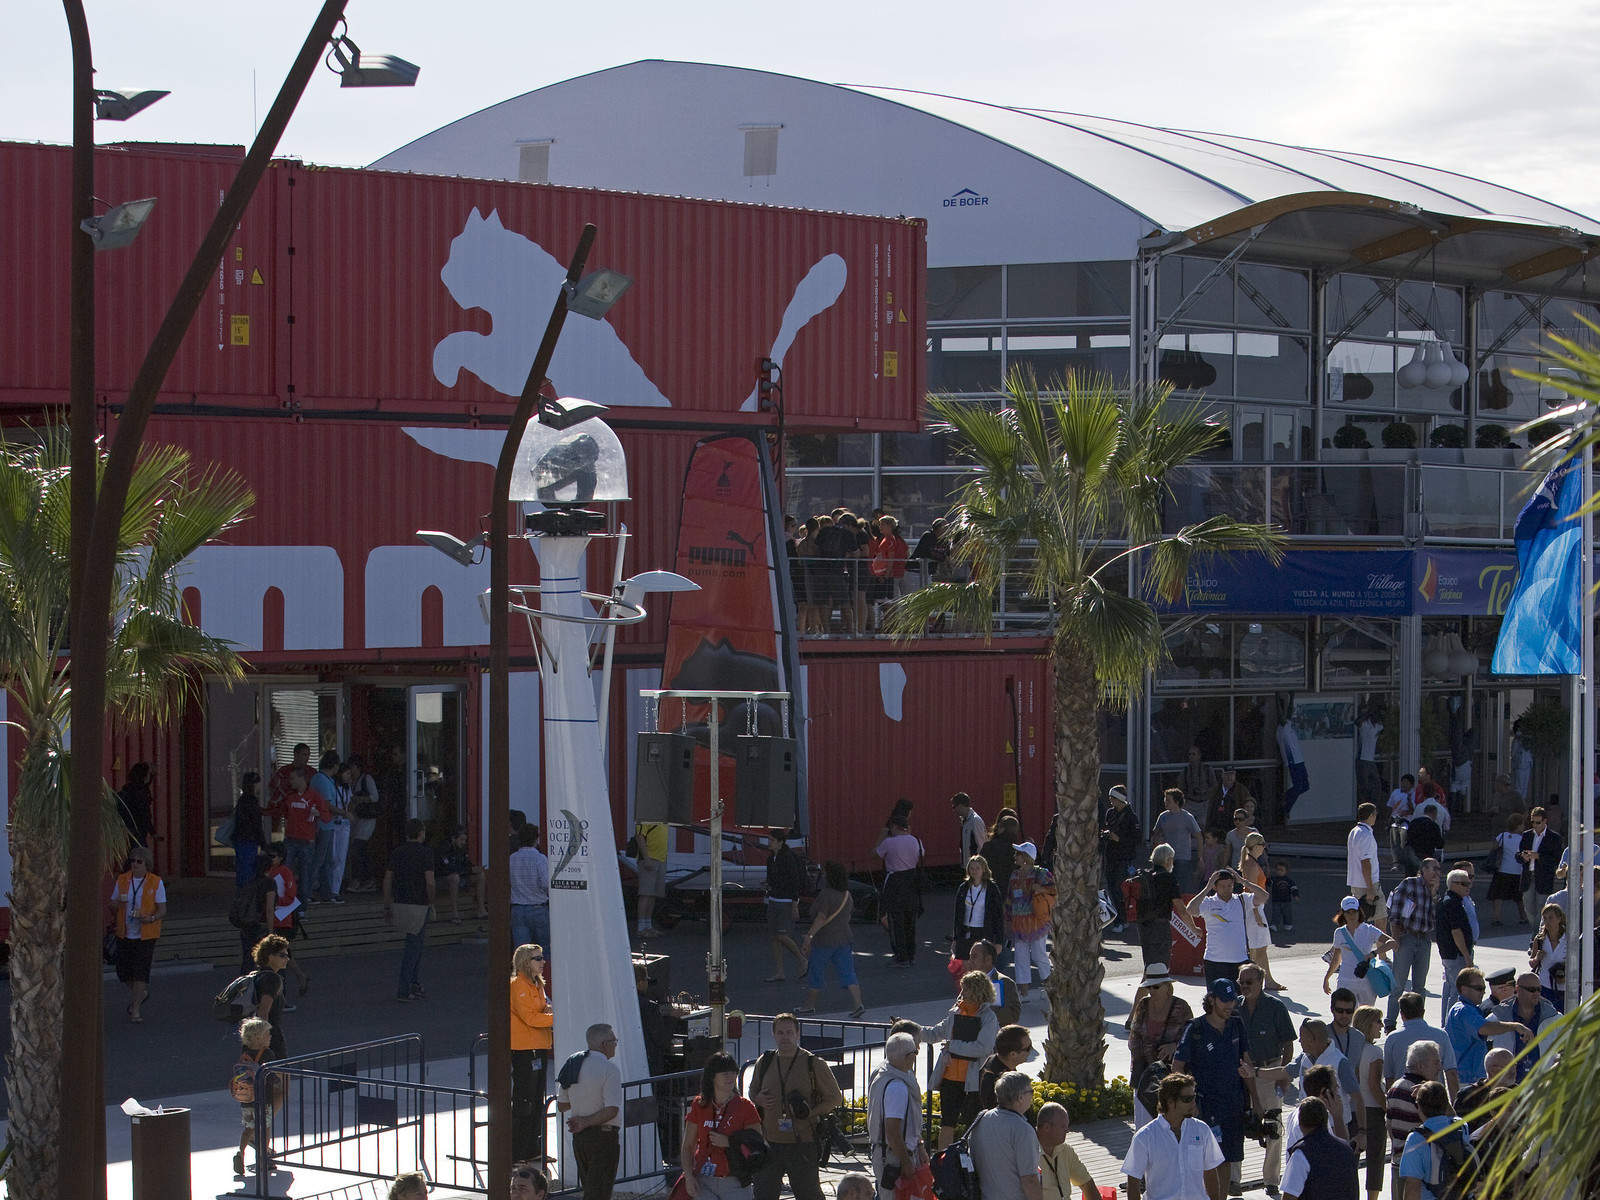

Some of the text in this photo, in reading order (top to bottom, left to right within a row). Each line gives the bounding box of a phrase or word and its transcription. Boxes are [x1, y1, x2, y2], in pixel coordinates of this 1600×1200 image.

[943, 196, 989, 207] DE BOER
[688, 546, 746, 567] PUMA
[687, 568, 746, 578] puma.com
[1187, 576, 1218, 588] Equipo
[1367, 573, 1405, 590] Village
[1438, 575, 1459, 587] Equipo
[1293, 590, 1318, 598] VUELTA
[1320, 590, 1329, 598] AL
[1385, 599, 1405, 607] NEGRO
[549, 819, 589, 830] VOLVO
[549, 832, 589, 843] OCEAN
[549, 845, 589, 857] RACE
[1171, 915, 1197, 942] TERRAZA
